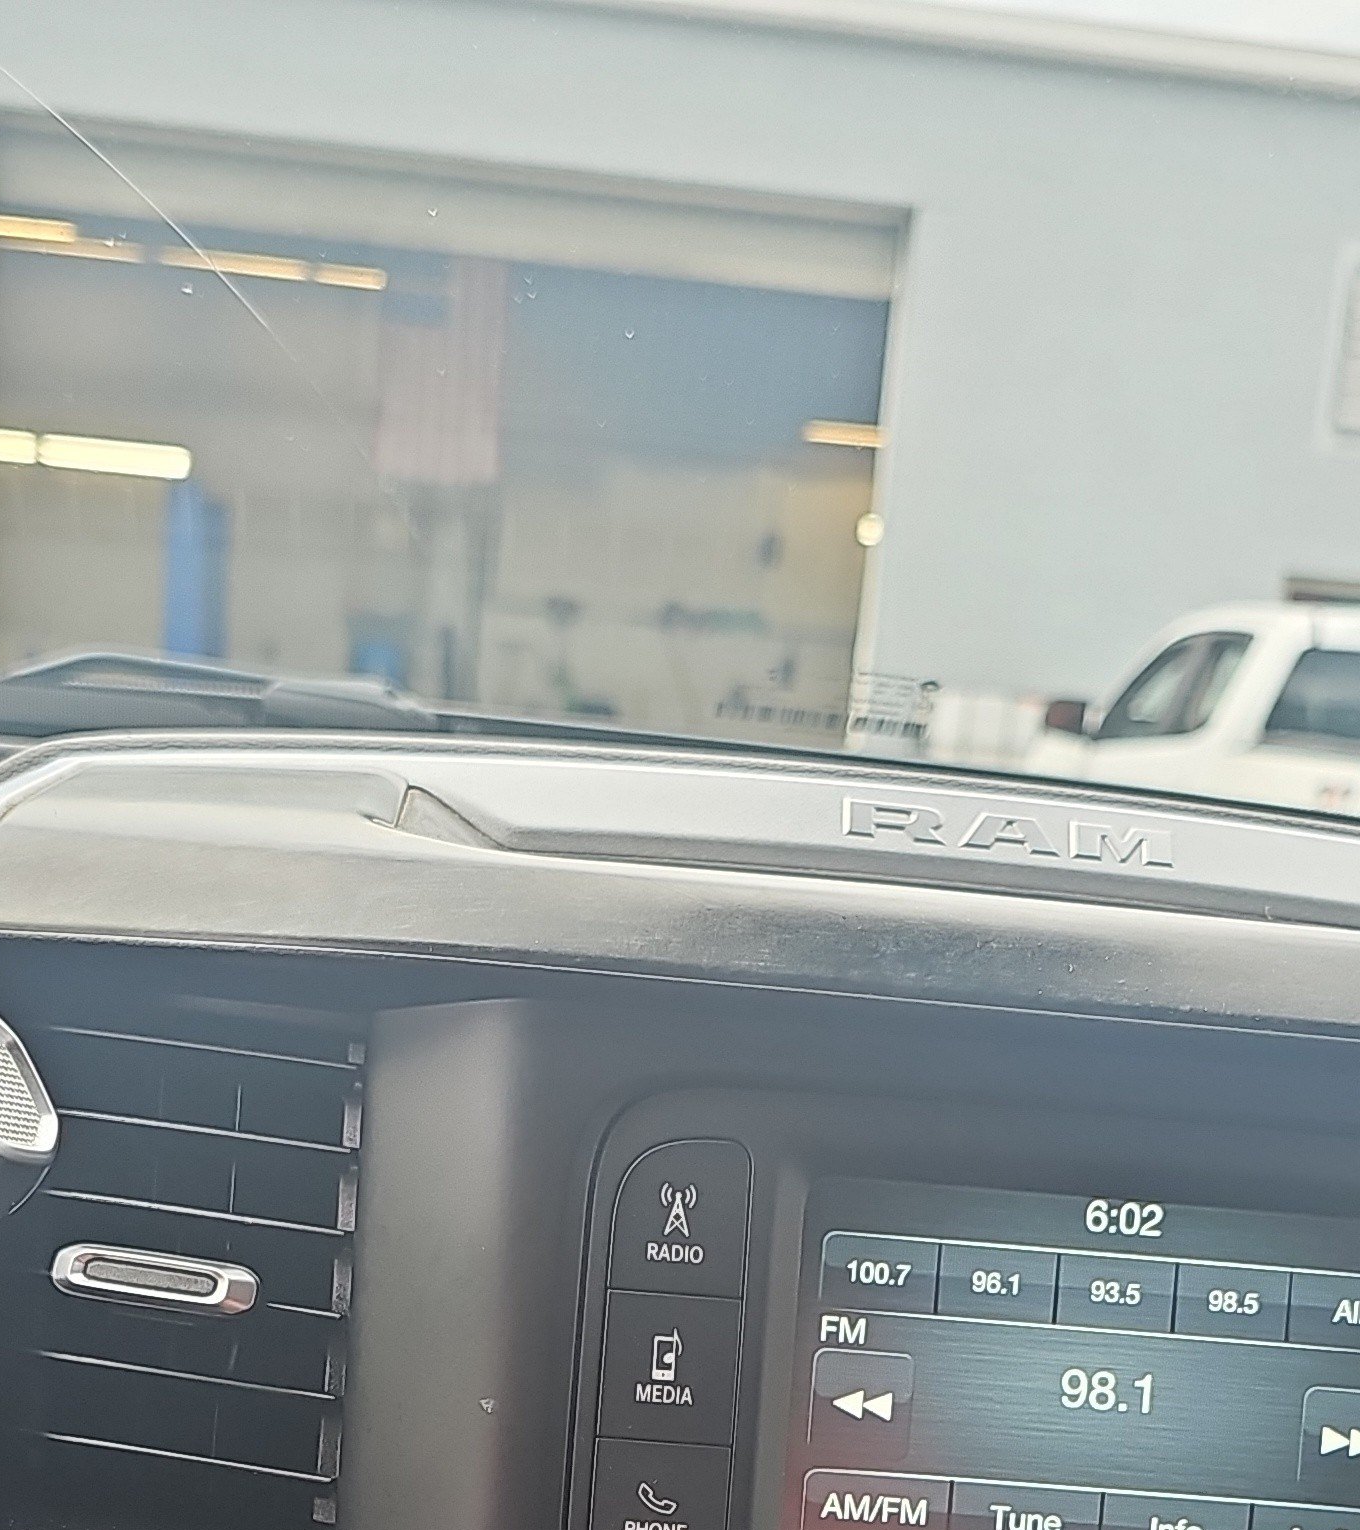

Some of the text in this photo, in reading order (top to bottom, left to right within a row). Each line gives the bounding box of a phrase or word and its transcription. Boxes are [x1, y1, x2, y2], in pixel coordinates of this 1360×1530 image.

[842, 797, 1174, 868] RAM
[1085, 1199, 1165, 1239] 6:02
[646, 1242, 704, 1265] RADIO
[846, 1259, 912, 1287] 100.7
[971, 1271, 1021, 1296] 96.1
[1089, 1279, 1142, 1307] 93.5
[1207, 1288, 1261, 1316] 98.5
[819, 1315, 867, 1345] FM
[635, 1383, 693, 1406] MEDIA
[1060, 1367, 1155, 1415] 98.1
[820, 1492, 928, 1527] AM/FM
